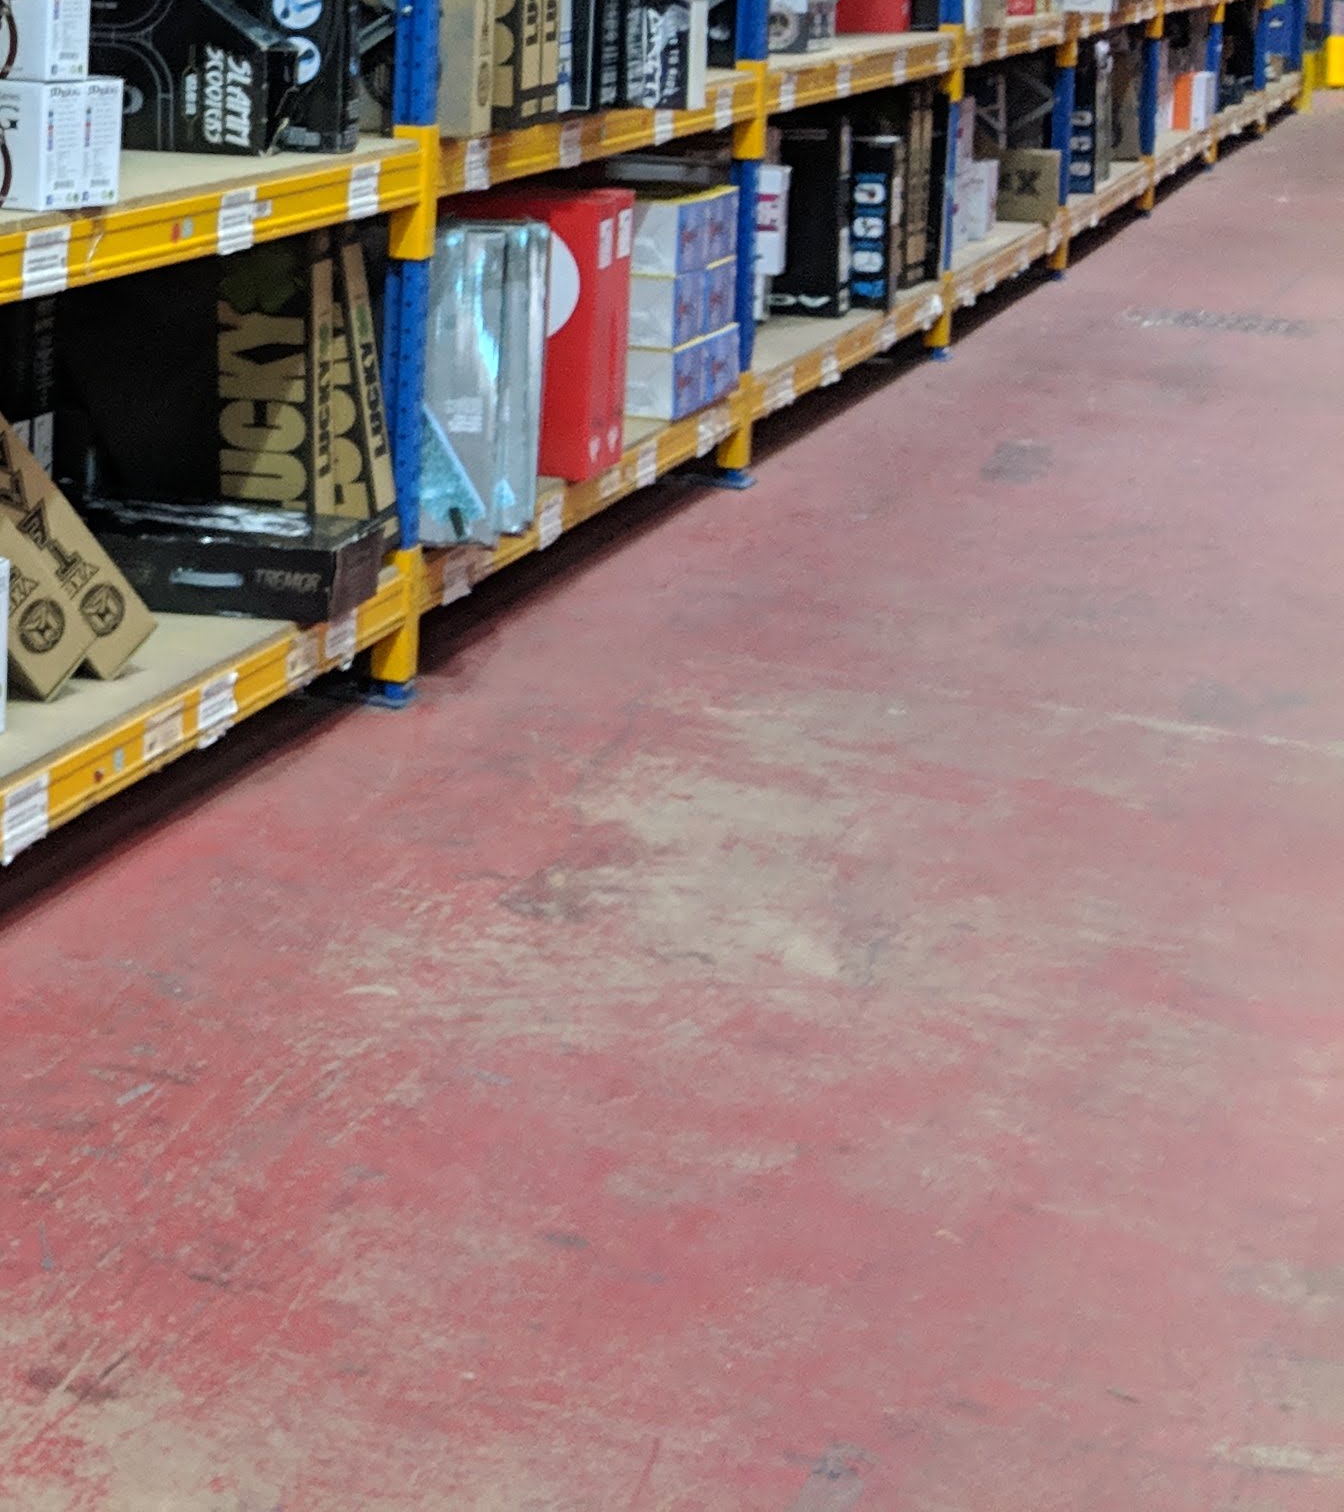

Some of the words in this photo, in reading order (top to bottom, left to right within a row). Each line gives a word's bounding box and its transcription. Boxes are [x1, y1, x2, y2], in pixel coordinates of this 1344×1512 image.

[224, 55, 253, 148] SLAMM
[217, 300, 308, 510] UCKY
[360, 342, 388, 460] LUCKY
[252, 568, 322, 593] TREMOR
